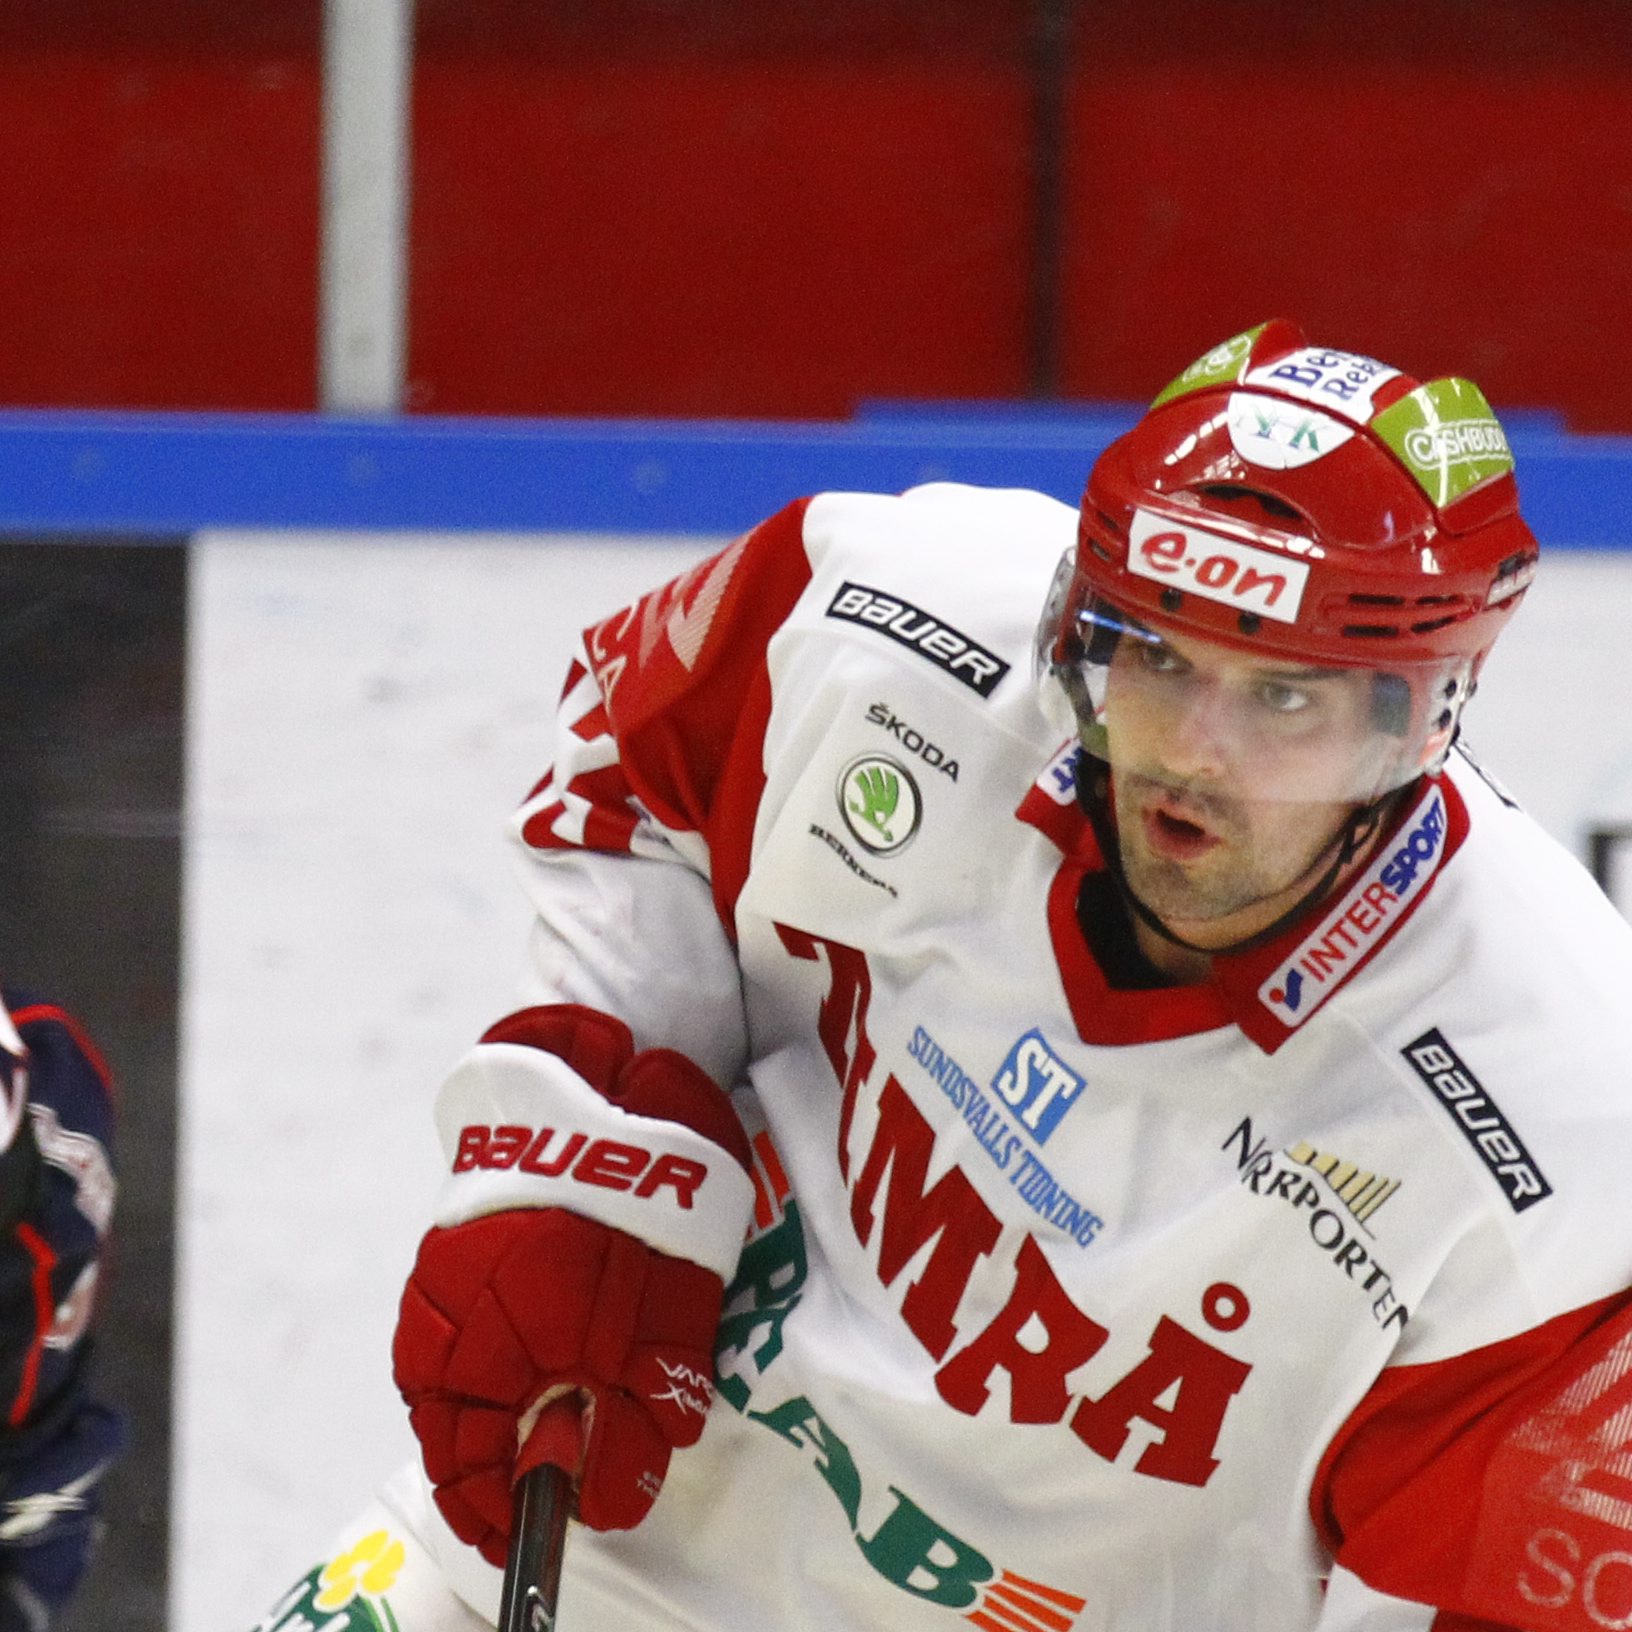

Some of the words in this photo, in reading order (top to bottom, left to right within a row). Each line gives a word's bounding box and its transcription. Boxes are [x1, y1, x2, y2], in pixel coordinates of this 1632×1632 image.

[833, 587, 1001, 687] BAUER
[865, 702, 962, 783] ŠKODA
[1298, 795, 1446, 984] INTERSPORT
[999, 1034, 1079, 1132] ST
[1410, 1043, 1543, 1200] BAUER
[452, 1124, 709, 1210] BAUER
[906, 1025, 1020, 1170] SUNDSVALLS
[1010, 1150, 1104, 1249] TIDNING
